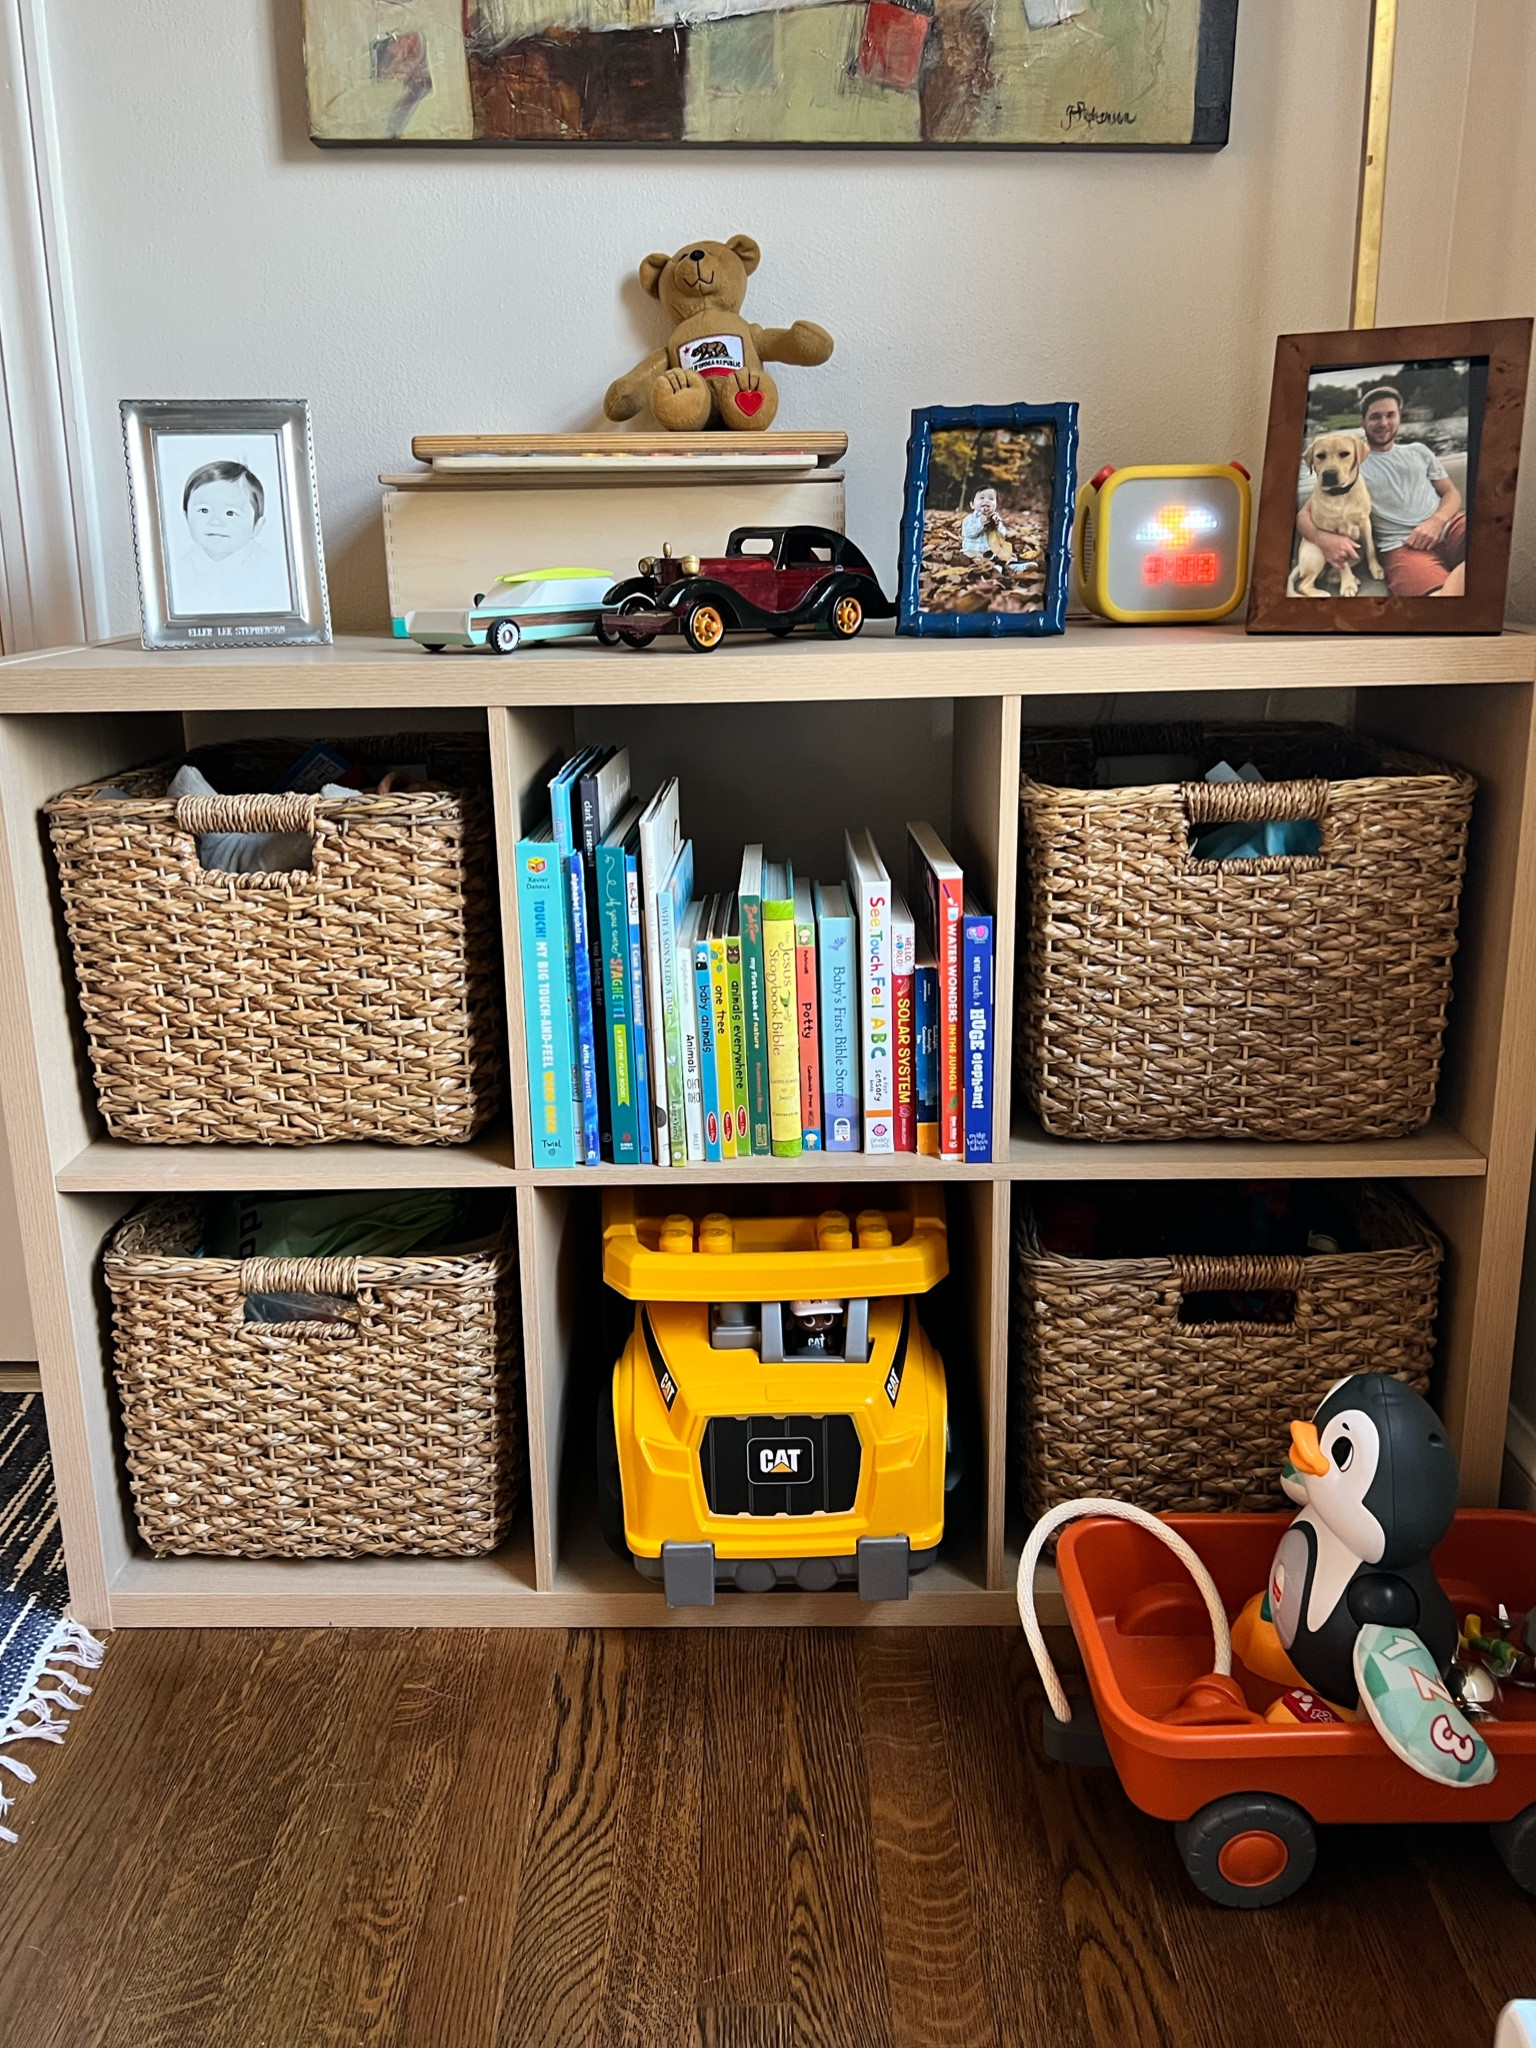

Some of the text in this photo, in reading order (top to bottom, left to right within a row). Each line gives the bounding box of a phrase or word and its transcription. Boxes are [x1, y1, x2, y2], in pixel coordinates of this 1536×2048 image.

[716, 360, 740, 368] REPUBLIC
[235, 626, 286, 636] STEPHENSON
[584, 801, 594, 821] clark
[586, 830, 596, 867] arsenault
[534, 900, 546, 938] TOUCH!
[571, 873, 583, 944] alphabet hukilau
[606, 909, 619, 928] you
[662, 906, 670, 927] WHY
[536, 942, 548, 957] MY
[610, 930, 620, 953] were
[662, 938, 670, 957] SON
[537, 961, 550, 980] BIG
[592, 941, 604, 1006] you belong here
[632, 949, 640, 968] Can
[664, 958, 672, 986] NEEDS
[749, 957, 756, 970] my
[778, 942, 794, 986] Jesus
[610, 958, 626, 1018] SPAGHETTI
[750, 972, 758, 988] first
[870, 977, 886, 1008] Feel
[972, 974, 983, 999] touch
[633, 984, 643, 1026] Anything!
[700, 985, 713, 1052] baby animals
[753, 1012, 760, 1022] of
[766, 949, 784, 1056] Storybook Bible
[948, 923, 958, 1090] WATER WONDERS IN THE JUNGLE
[538, 984, 554, 1068] TOUCH-AND-FEEL
[716, 1010, 726, 1034] tree
[732, 980, 745, 1090] animals everywhere
[802, 1002, 814, 1038] Potty
[968, 1008, 986, 1050] HUGE
[686, 1034, 696, 1072] Animals
[832, 966, 848, 1108] Baby's First Bible Stories
[870, 1017, 887, 1059] ABC
[898, 998, 911, 1103] SOLAR SYSTEM
[582, 1044, 590, 1064] Arita
[618, 1035, 626, 1076] LIFT-THE-FLAP
[584, 1070, 592, 1098] Merritt
[874, 1070, 882, 1102] sensory
[971, 1052, 984, 1109] elephant!
[660, 1372, 675, 1402] CAT
[886, 1366, 900, 1401] CAT
[760, 1449, 801, 1474] CAT
[1380, 1635, 1421, 1661] 1
[1430, 1714, 1475, 1764] 3
